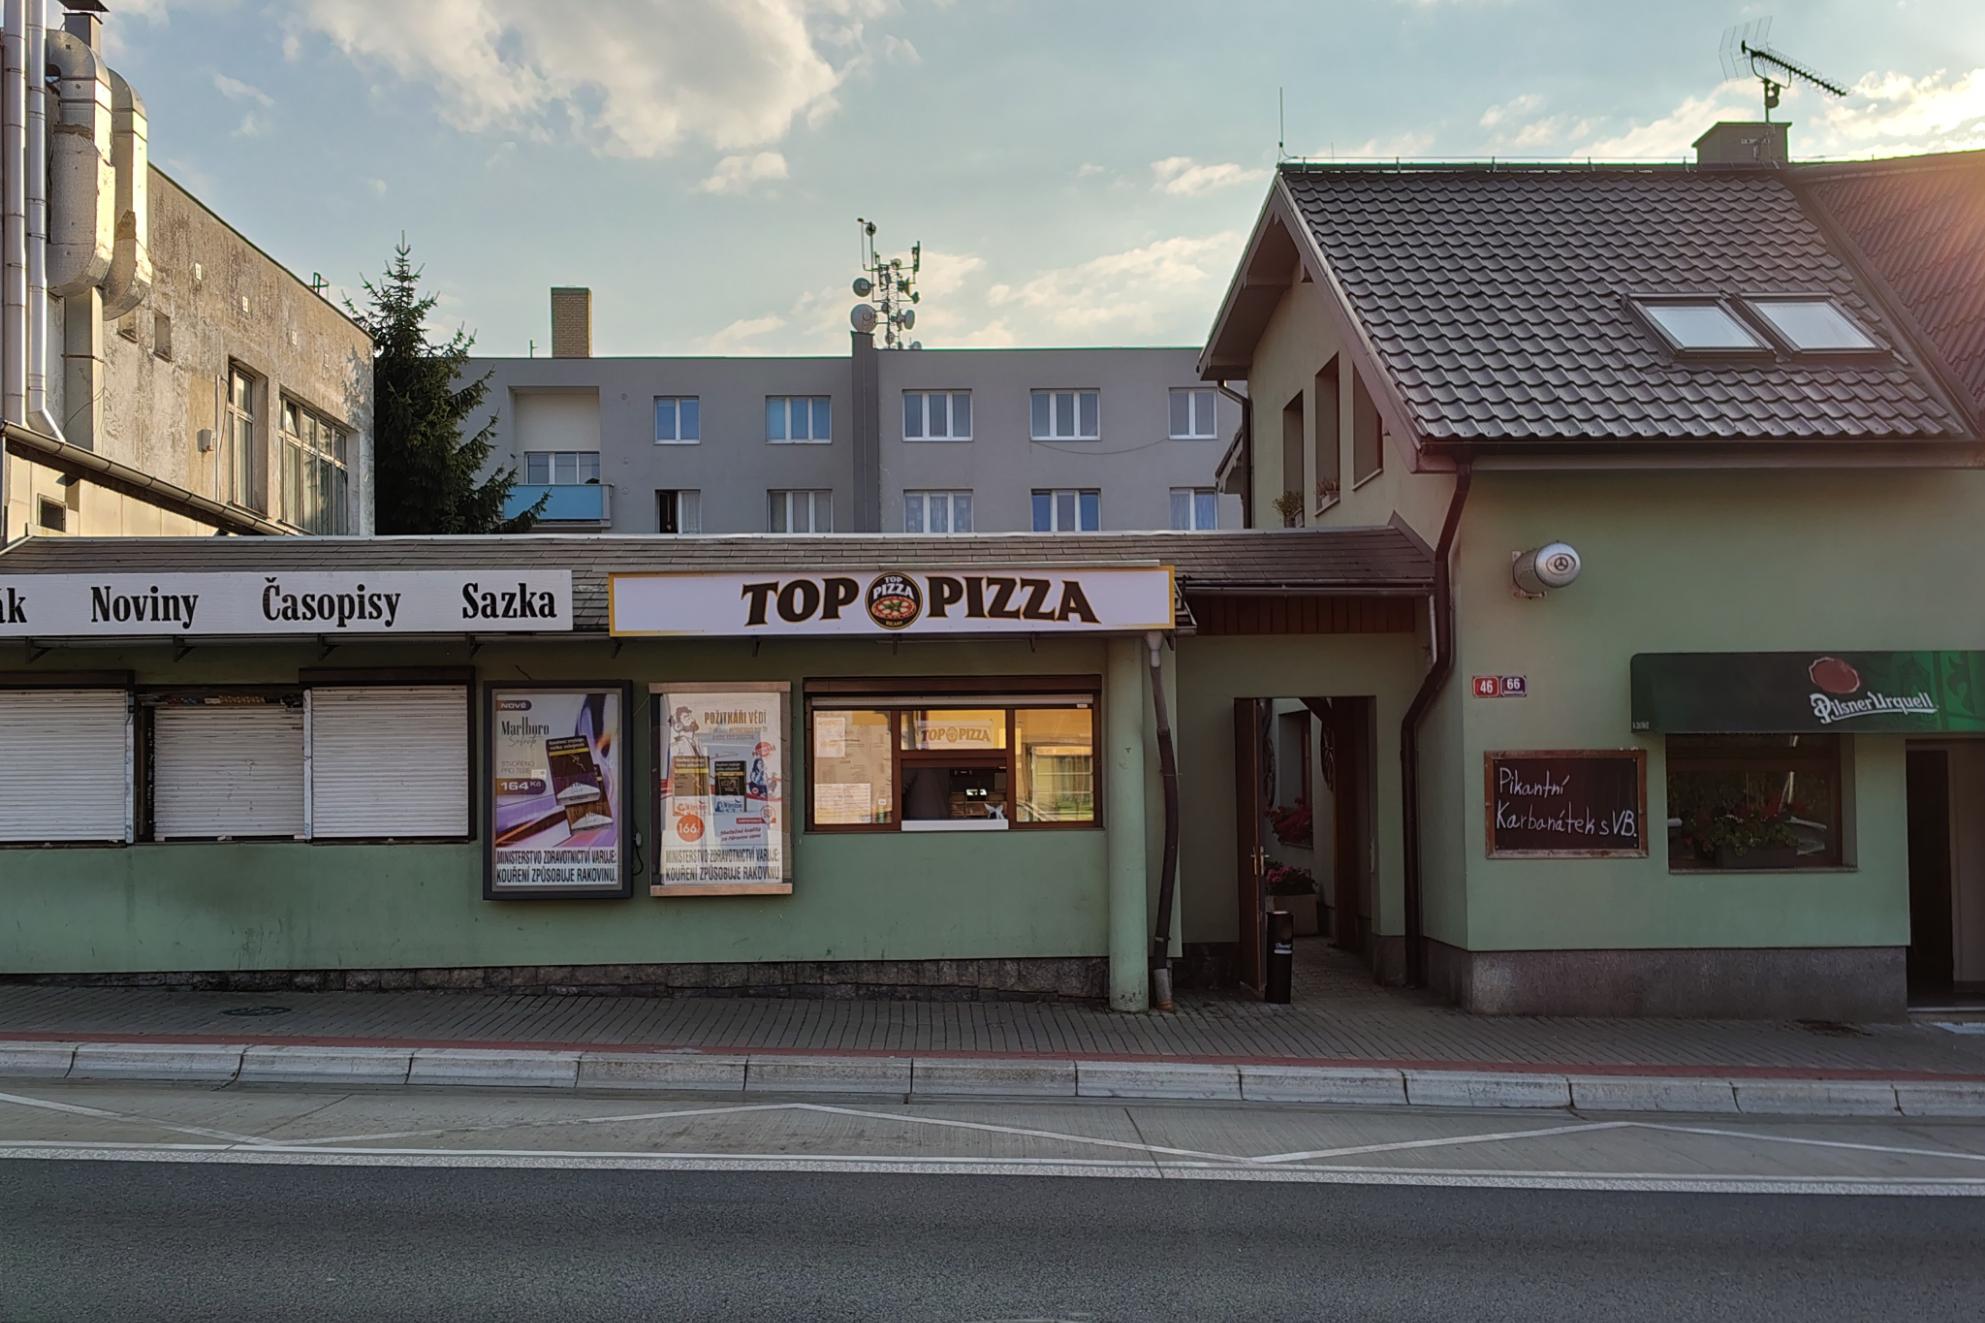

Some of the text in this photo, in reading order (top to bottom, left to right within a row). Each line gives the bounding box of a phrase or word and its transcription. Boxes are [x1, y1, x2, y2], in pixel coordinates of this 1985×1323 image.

[884, 576, 904, 584] TOP
[873, 583, 915, 600] PIZZA
[0, 577, 557, 630] k Noviny Časopisy Sazka
[741, 576, 1102, 627] TOP PIZZA
[1480, 679, 1494, 694] 46
[1506, 678, 1521, 690] 66
[1808, 691, 1935, 724] Pilsner Urquell
[501, 717, 550, 736] Marlboro
[921, 727, 991, 742] TOP PIZZA
[500, 781, 530, 791] 164
[1499, 767, 1570, 799] Pikantní
[1496, 799, 1595, 835] Karbanátek
[1599, 820, 1609, 836] s
[496, 850, 542, 865] MINISTERSTVO
[543, 847, 591, 864] ZDRAVOTNICTVÍ
[496, 866, 530, 883] KOUŘENÍ
[531, 865, 576, 883] ZPŮSOBUJE
[665, 864, 698, 881] KOUŘENÍ
[699, 864, 742, 881] ZPŮSOBUJE
